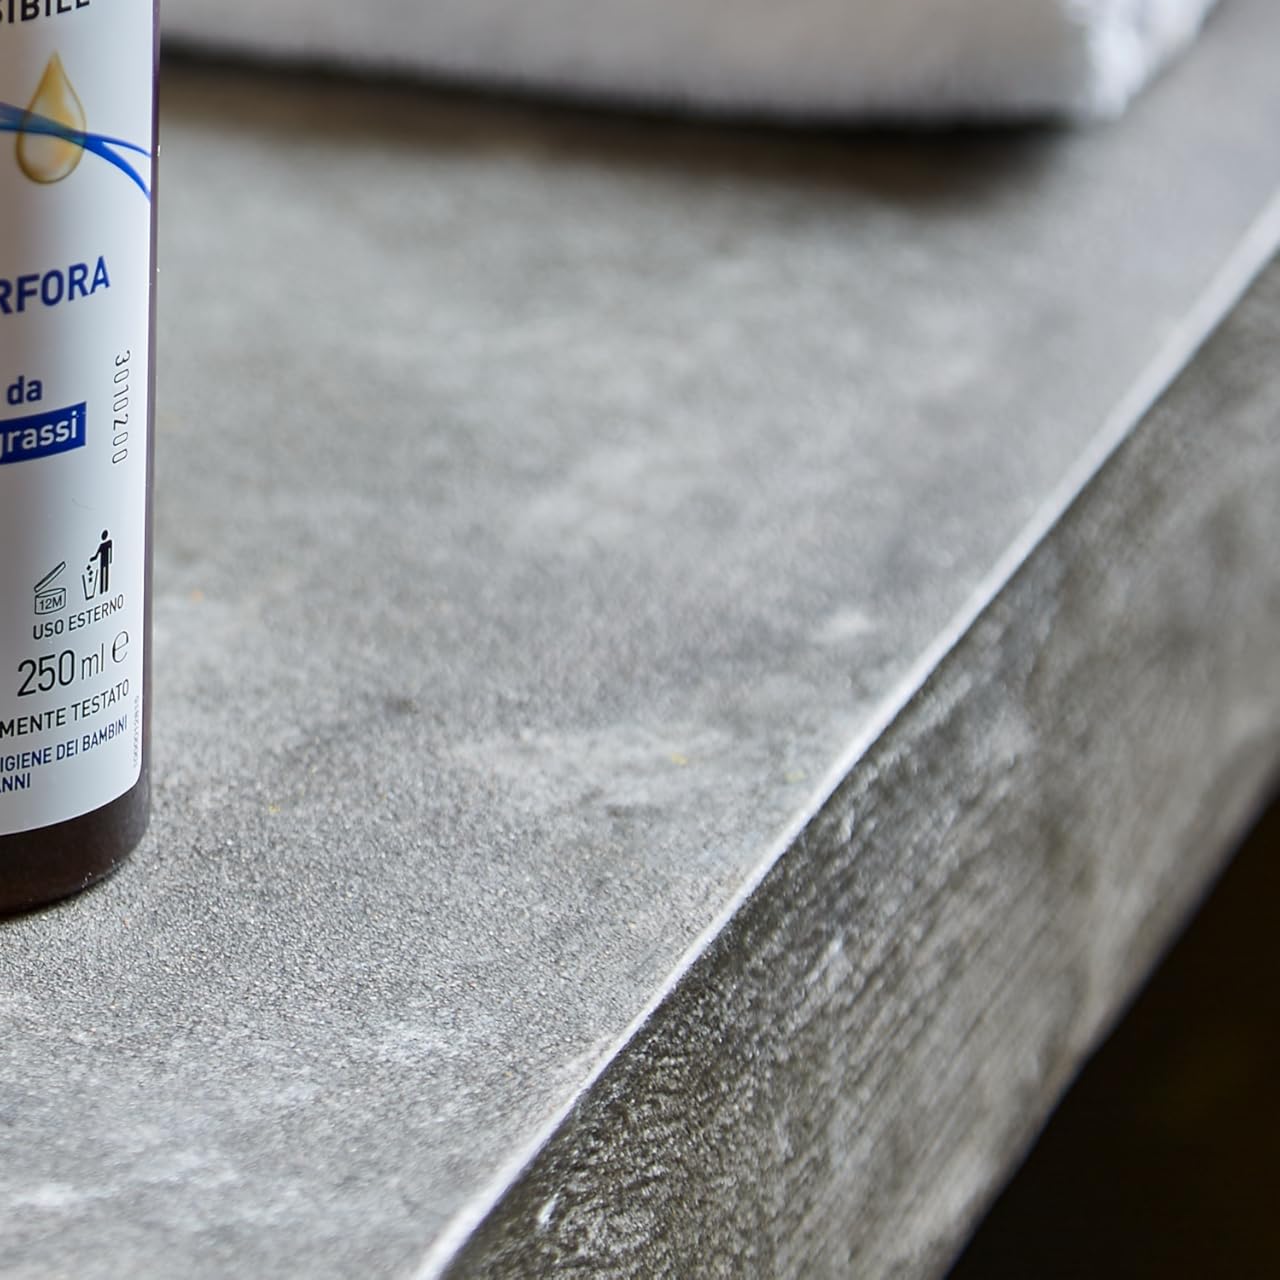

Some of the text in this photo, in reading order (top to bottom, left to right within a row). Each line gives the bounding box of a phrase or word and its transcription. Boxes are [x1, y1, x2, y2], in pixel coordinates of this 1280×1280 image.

[6, 375, 43, 405] da
[32, 594, 125, 641] USO ESTERNO
[39, 594, 64, 612] 12M
[16, 649, 76, 697] 250
[80, 643, 105, 680] ml
[71, 678, 130, 722] TESTATO
[56, 736, 80, 762] DEI
[82, 713, 128, 754] BAMBINI
